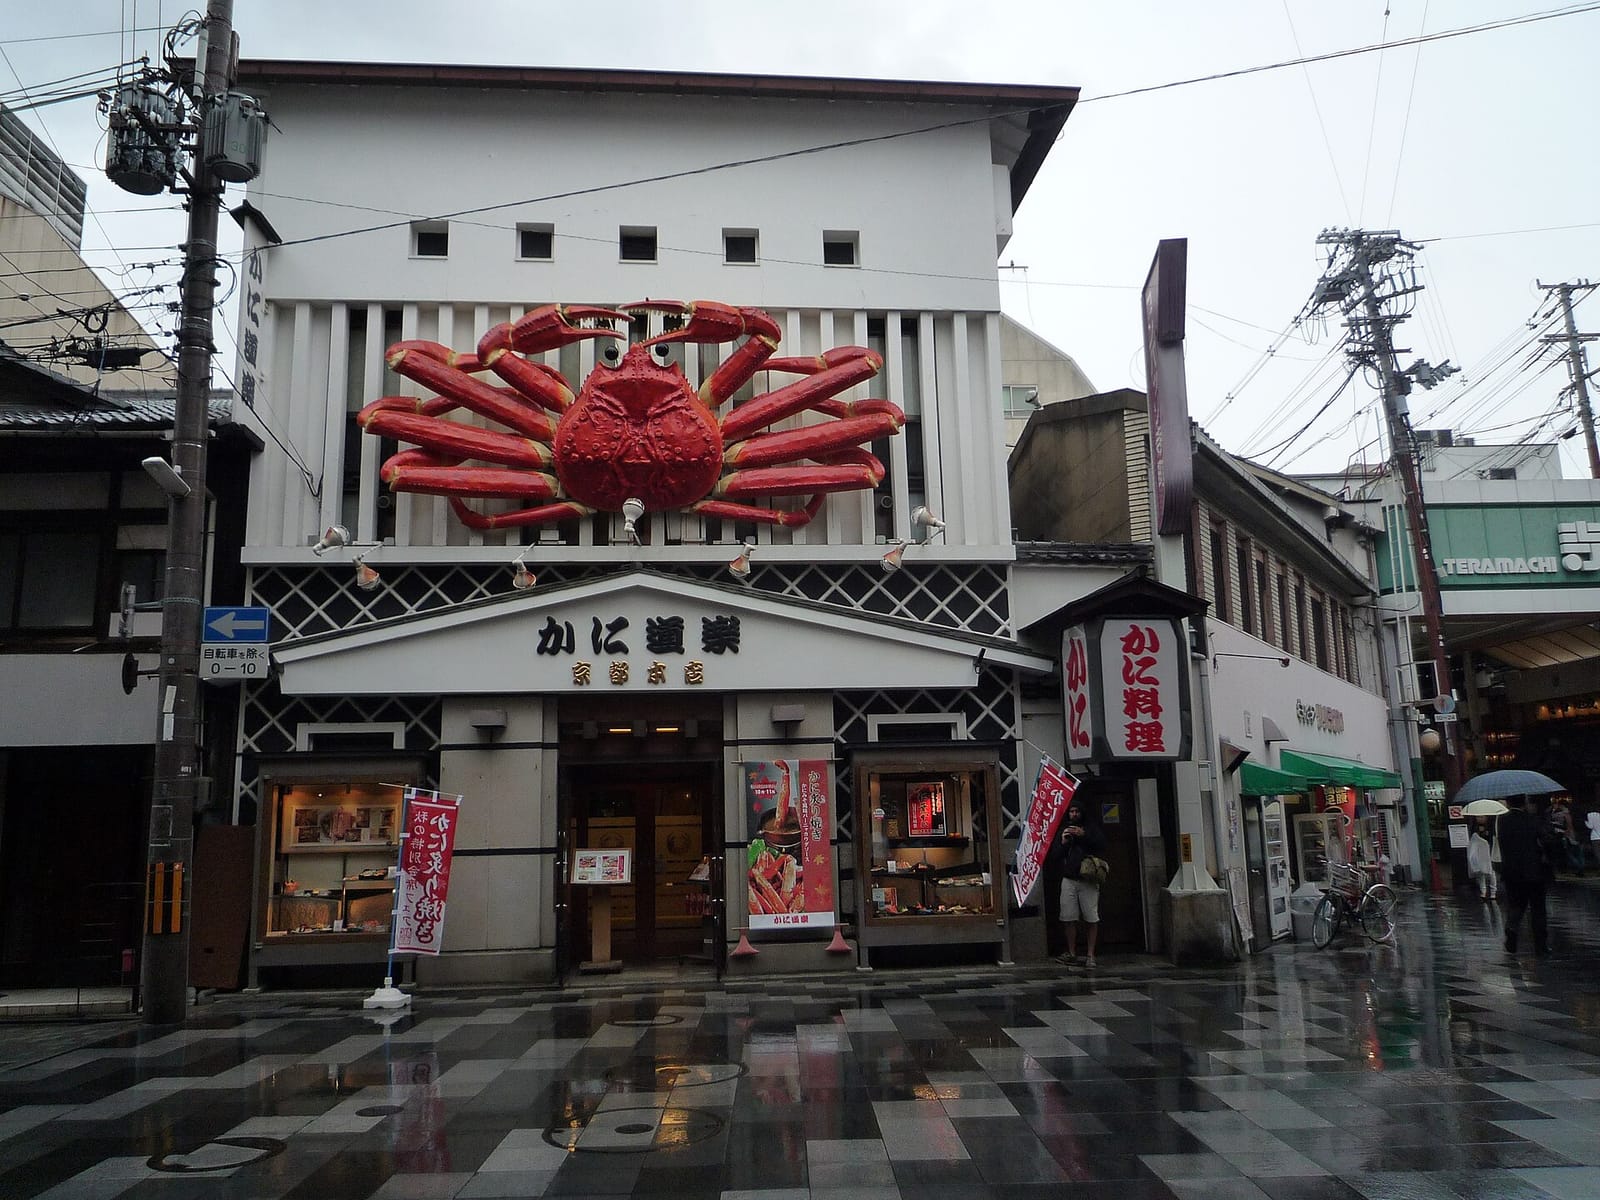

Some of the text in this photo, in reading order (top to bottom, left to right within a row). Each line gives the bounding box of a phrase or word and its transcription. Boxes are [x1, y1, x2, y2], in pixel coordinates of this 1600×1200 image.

[1443, 556, 1558, 575] TERAMACHI
[204, 648, 264, 660] 自転車を除く
[537, 616, 741, 655] かに道楽
[572, 661, 704, 685] 京都本店
[1120, 624, 1166, 753] かに料理
[1066, 638, 1091, 749] かに
[808, 770, 823, 842] かに炙り焼き
